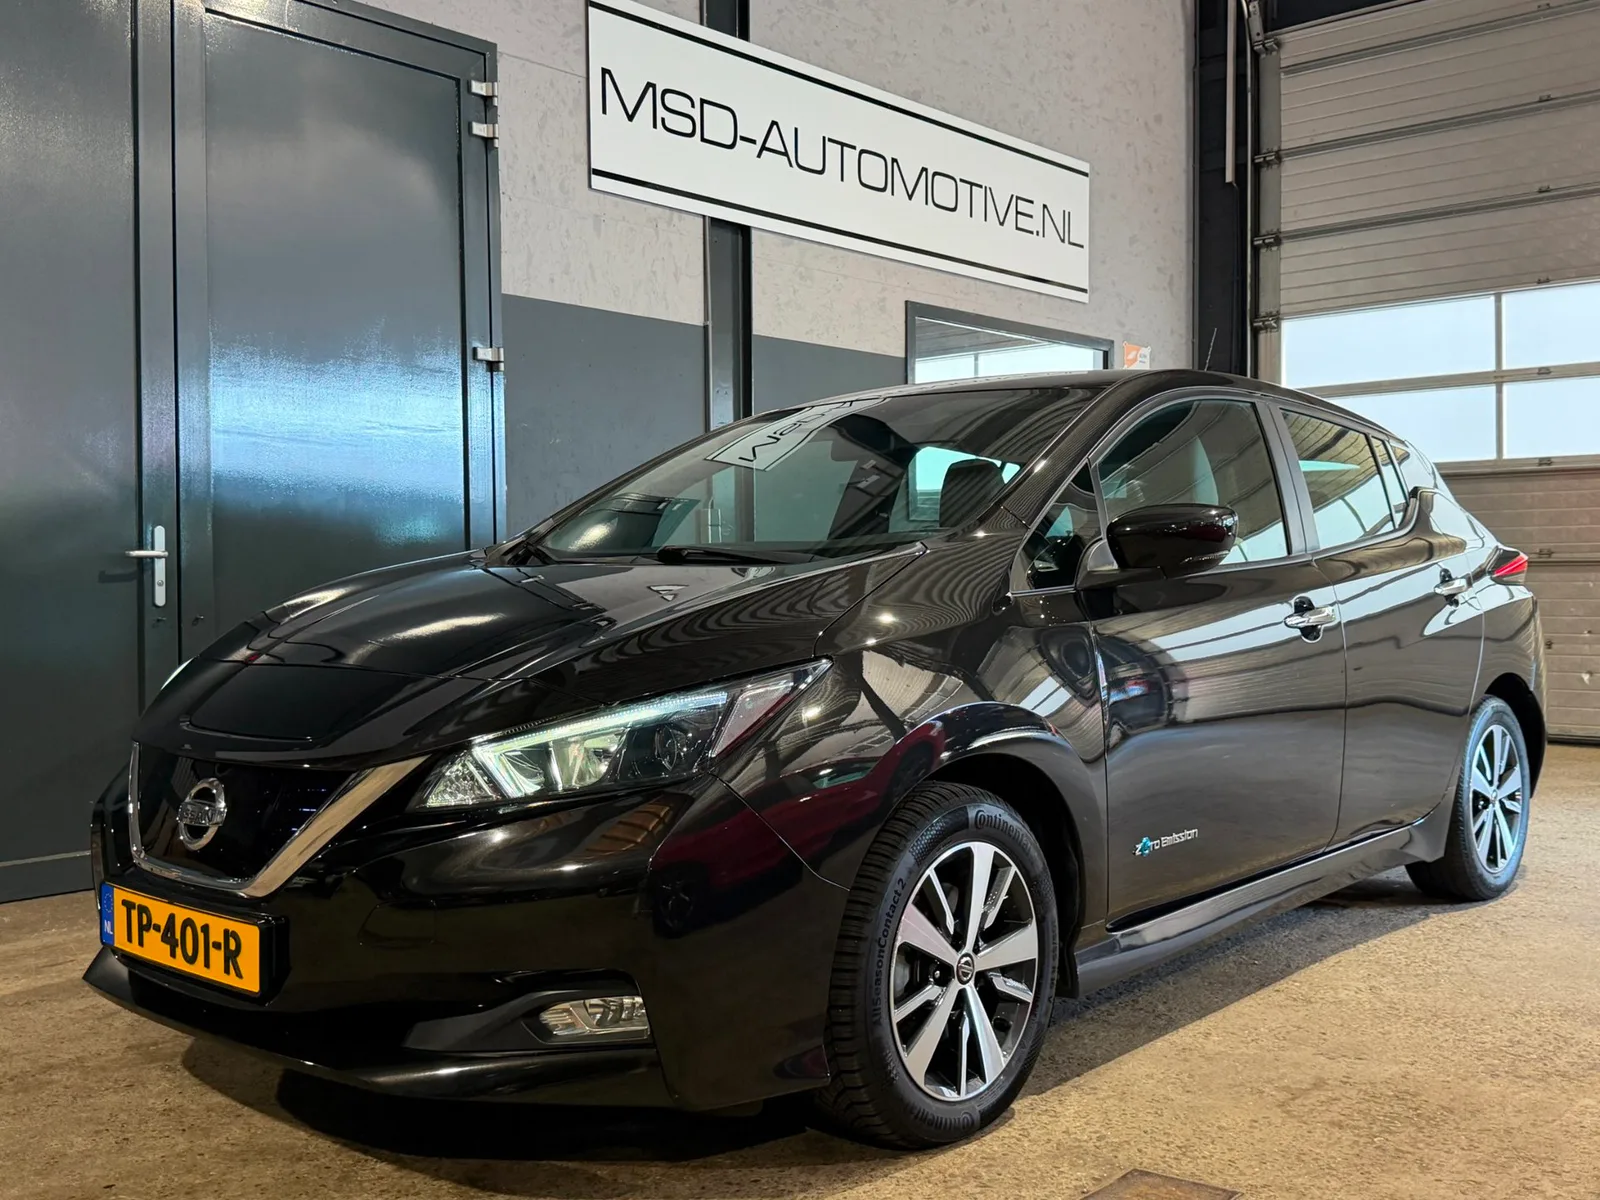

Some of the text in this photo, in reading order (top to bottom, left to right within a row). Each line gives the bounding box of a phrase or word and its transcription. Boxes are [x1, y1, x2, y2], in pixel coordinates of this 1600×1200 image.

[600, 66, 1085, 249] MSD-AUTOMOTIVE.NL
[104, 919, 114, 935] NL
[121, 899, 243, 980] TP-401-R
[871, 877, 907, 1026] AllSeasonContact 2
